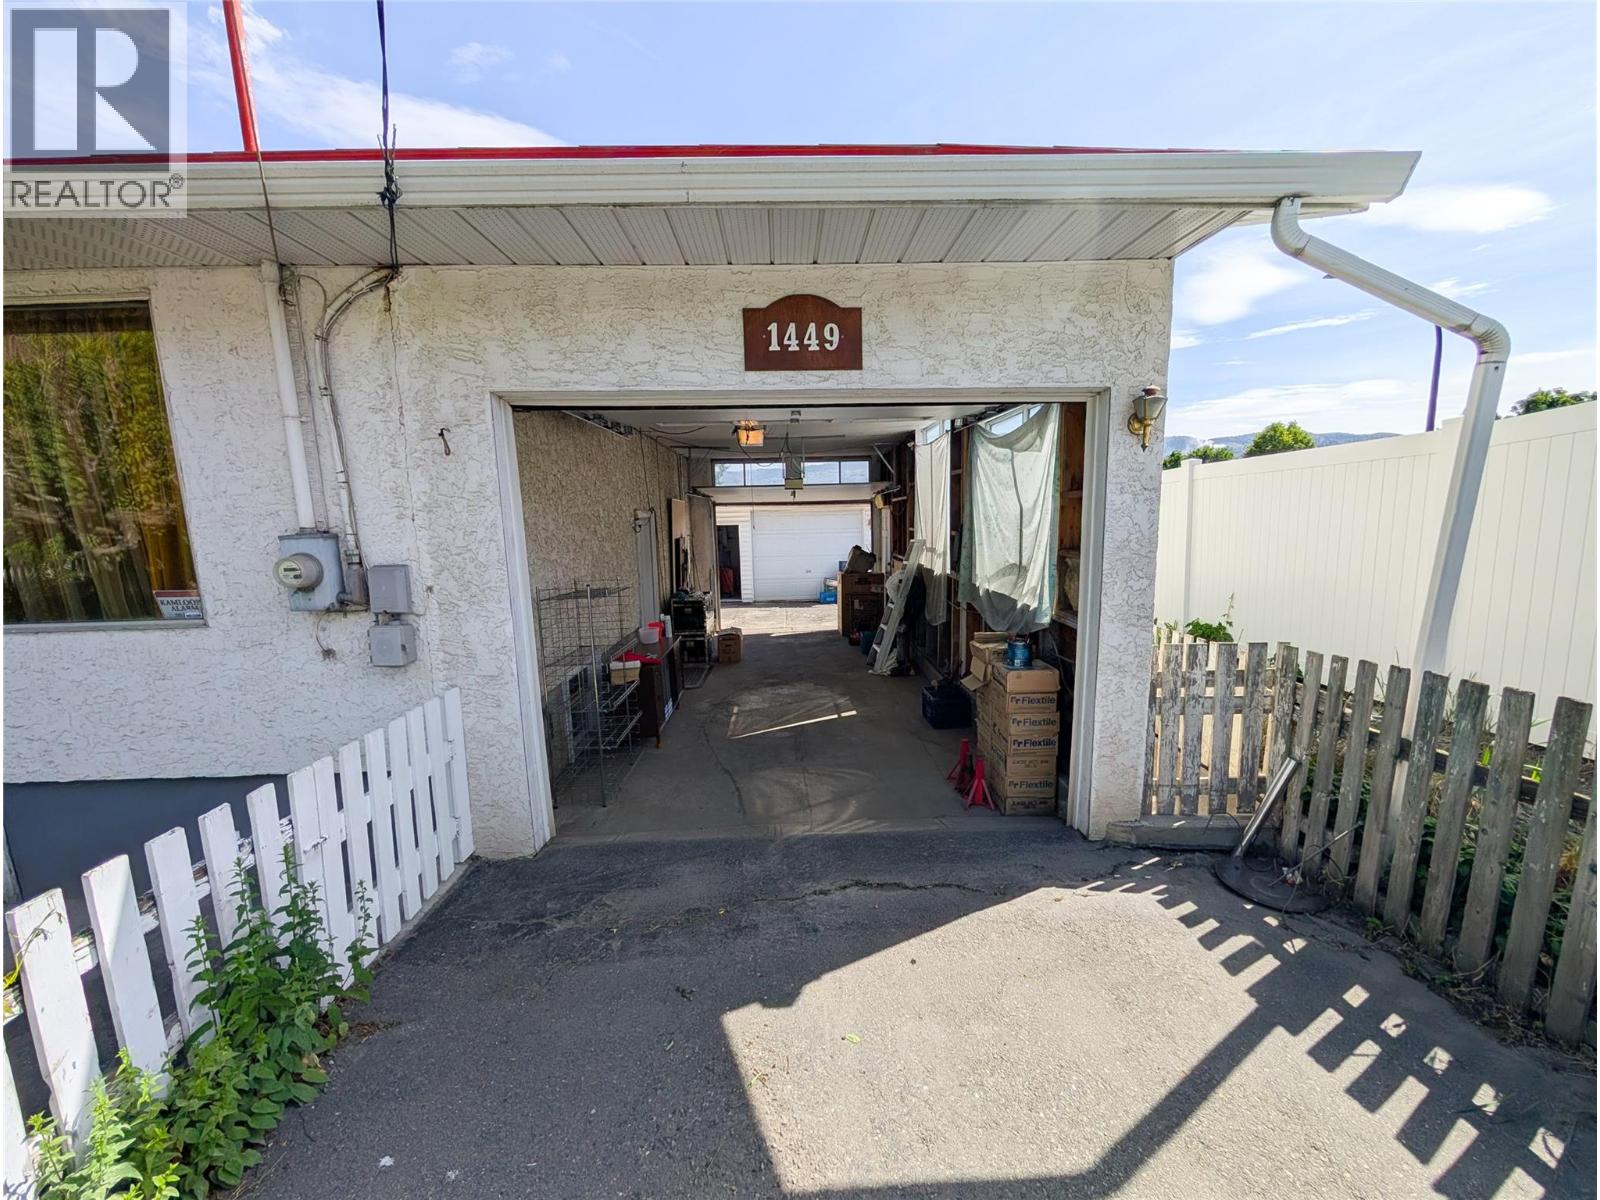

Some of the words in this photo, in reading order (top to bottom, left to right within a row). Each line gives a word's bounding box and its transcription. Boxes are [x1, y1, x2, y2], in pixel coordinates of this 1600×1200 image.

[767, 322, 840, 352] 1449
[1021, 696, 1056, 705] Flextile
[1023, 717, 1057, 727] Flextile
[1023, 738, 1057, 747] Flextile
[1020, 780, 1053, 789] Flextile
